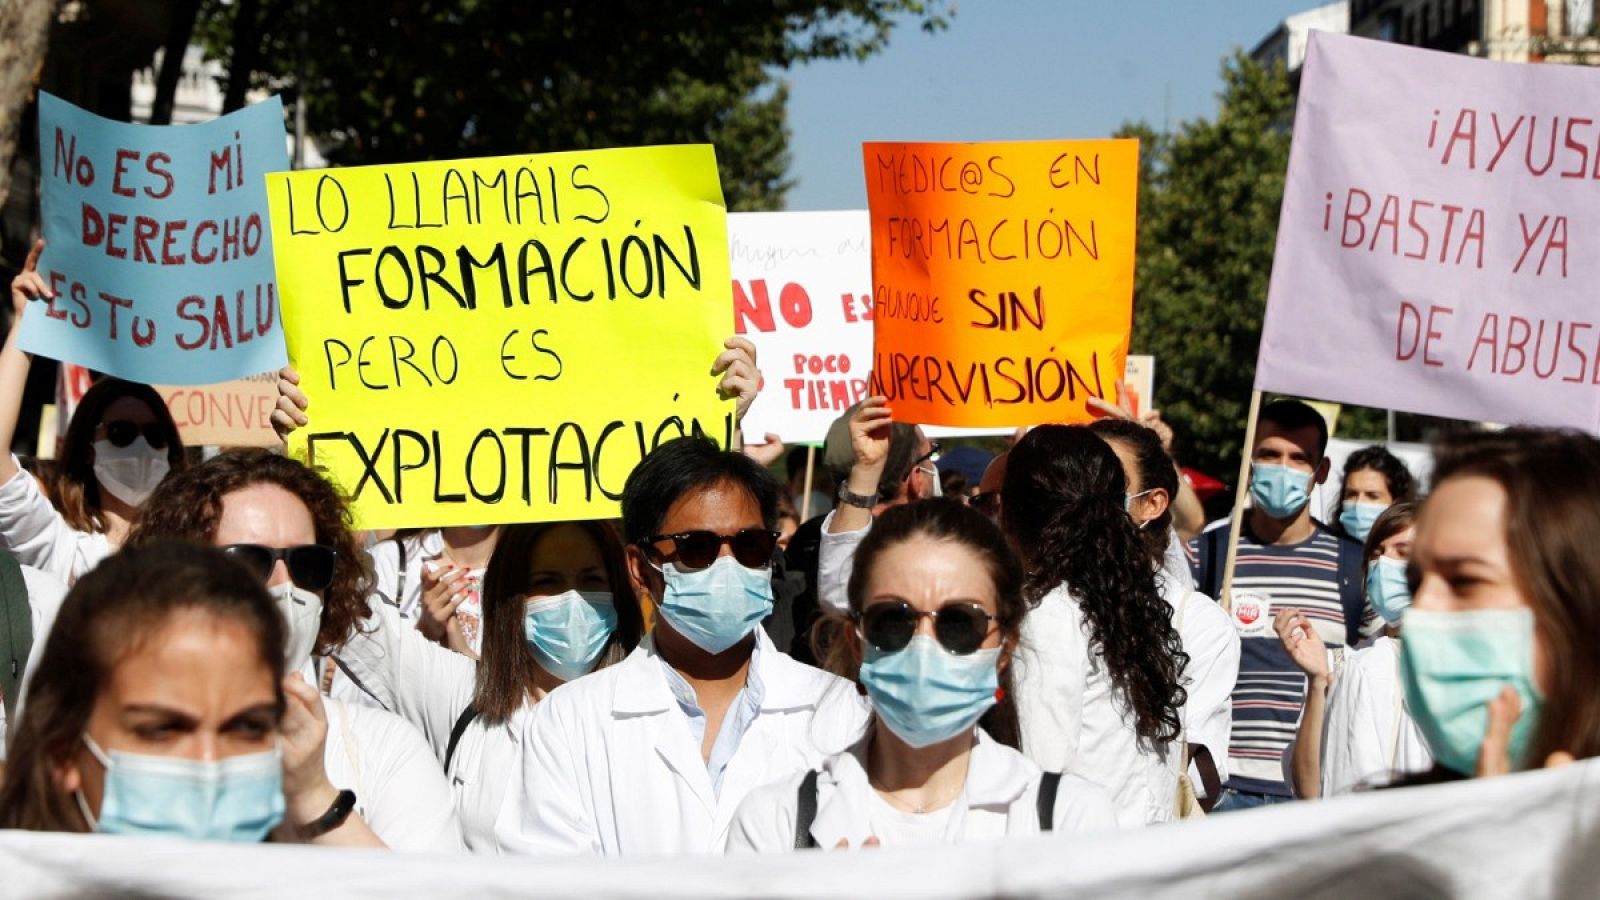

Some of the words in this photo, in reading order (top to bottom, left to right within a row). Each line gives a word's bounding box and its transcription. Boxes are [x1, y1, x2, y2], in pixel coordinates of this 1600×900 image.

[112, 149, 174, 199] ES
[286, 174, 350, 236] LO
[383, 158, 611, 230] LLAMÁIS
[876, 147, 1016, 198] MÉDIC@S
[1048, 152, 1101, 189] EN
[81, 201, 262, 265] DERECHO
[887, 208, 1099, 264] FORMACIÓN
[1512, 212, 1568, 278] YA
[337, 219, 702, 314] FORMACIÓN
[45, 272, 92, 328] ES
[175, 282, 283, 350] SALU
[732, 279, 812, 334] NO
[875, 284, 945, 324] AUNQUE
[968, 285, 1046, 332] SIN
[1396, 302, 1453, 367] DE
[323, 335, 458, 390] PERO
[501, 329, 563, 381] ES
[793, 353, 851, 375] POCO
